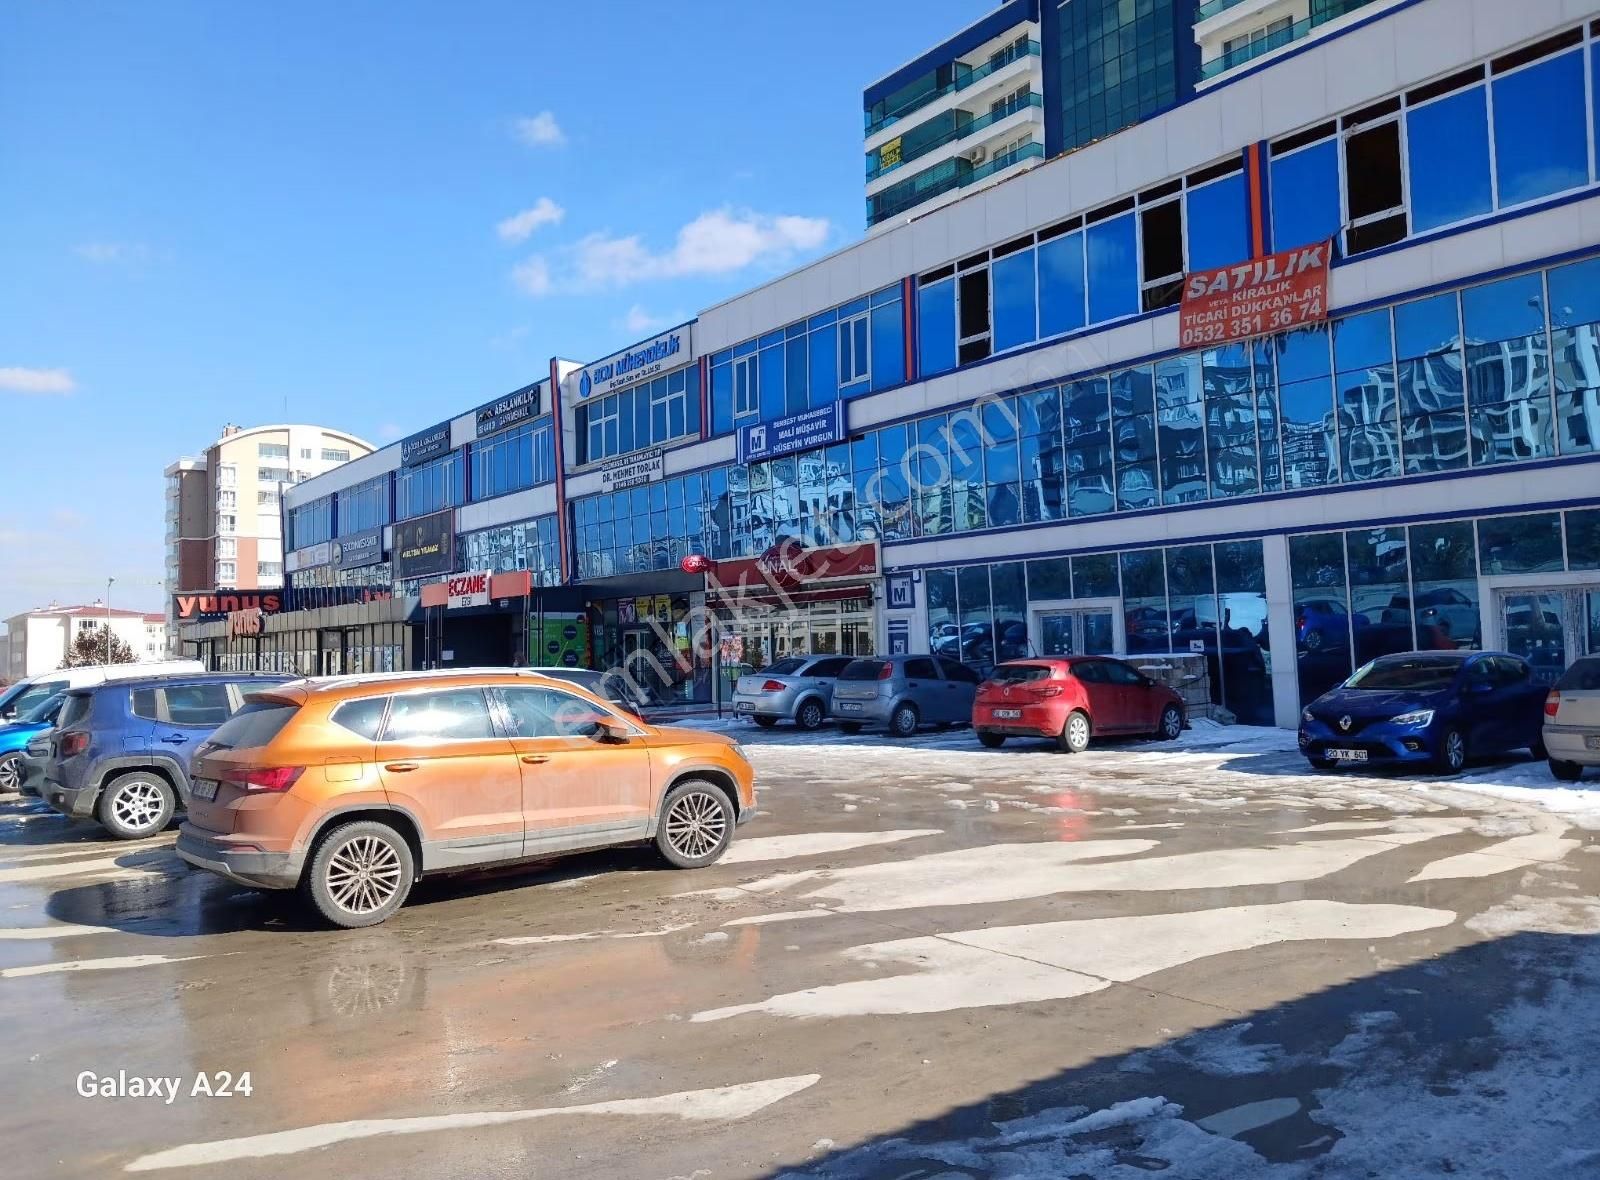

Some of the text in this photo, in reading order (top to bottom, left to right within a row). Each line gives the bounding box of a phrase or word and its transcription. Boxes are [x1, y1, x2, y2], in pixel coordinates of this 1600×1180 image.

[1188, 247, 1323, 299] SATILIK
[1233, 280, 1291, 302] KİRALIK
[1184, 285, 1322, 326] TİCARİ DÜKKANLAR
[1183, 299, 1322, 345] 0532 351 36 74
[615, 334, 680, 376] MÜHENDİSLİK
[779, 419, 827, 439] MALİ MÜŞAVİR
[773, 439, 802, 453] HÜSEYİN
[612, 466, 636, 481] MEHMET
[637, 459, 660, 474] TORLAK
[448, 574, 486, 597] ECZANE
[177, 595, 280, 617] yunus
